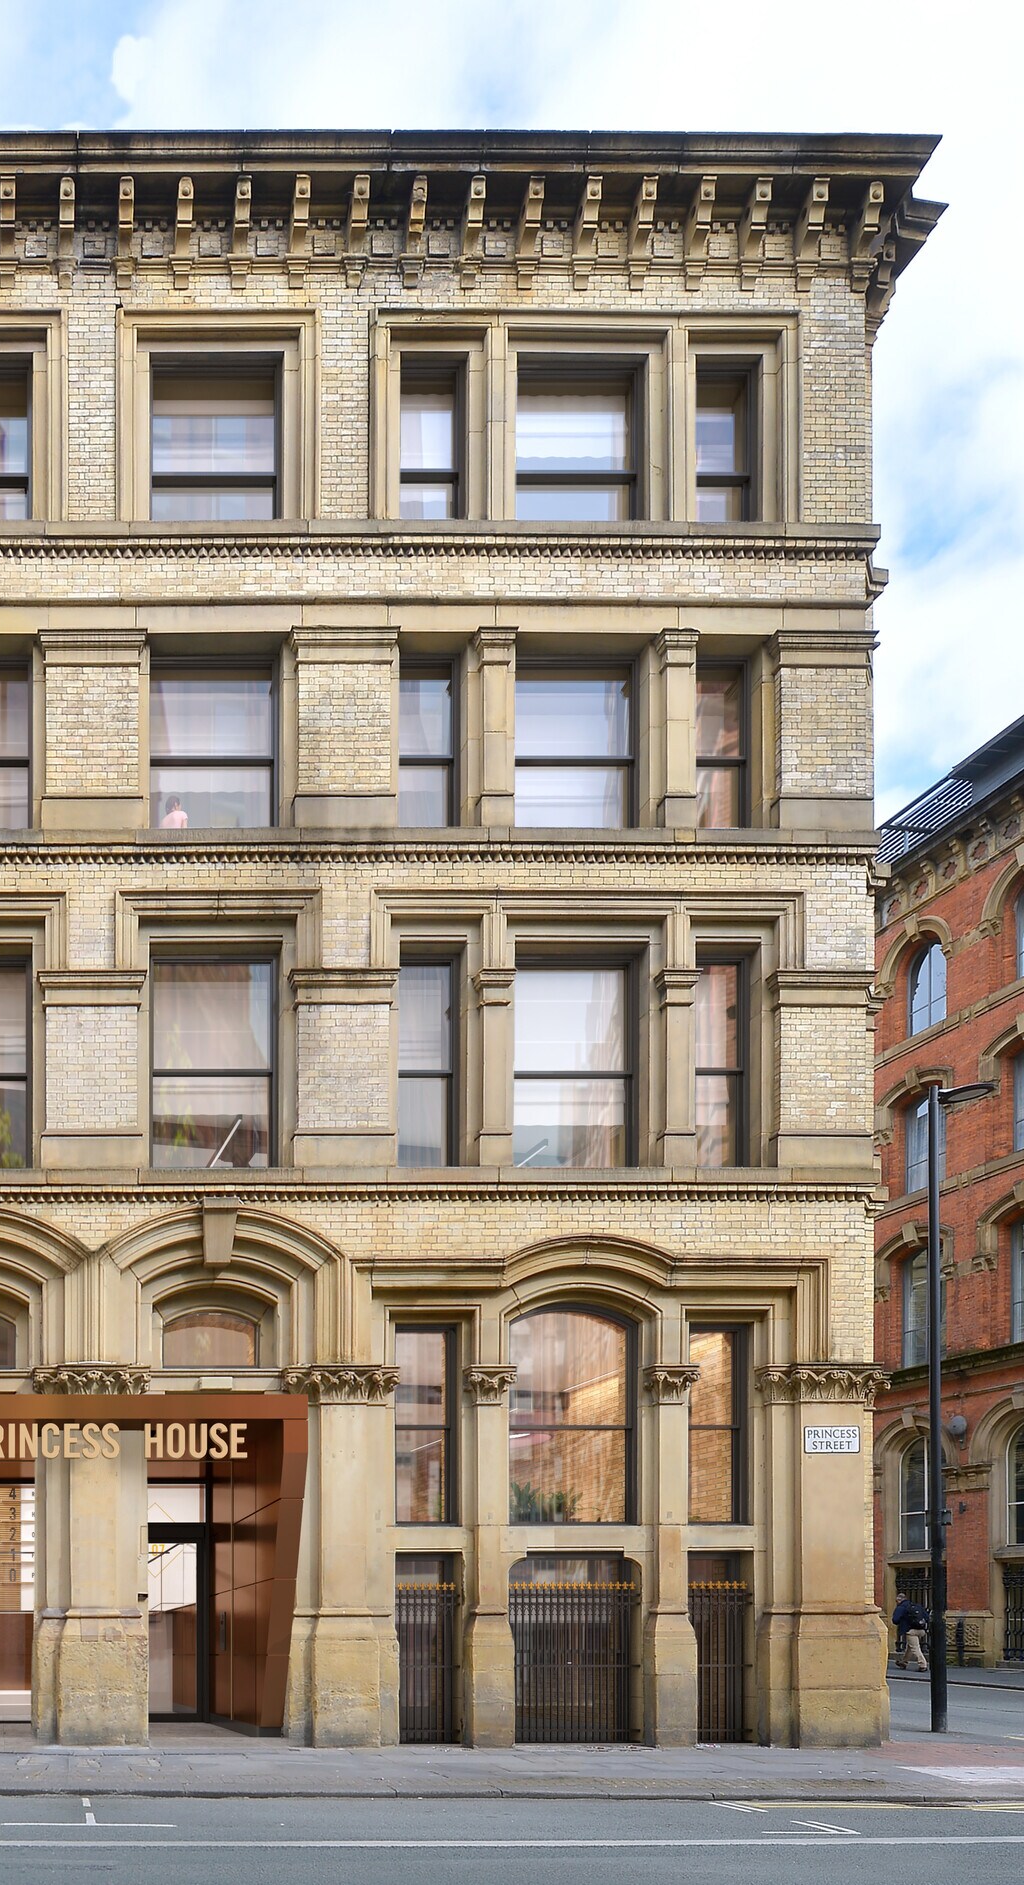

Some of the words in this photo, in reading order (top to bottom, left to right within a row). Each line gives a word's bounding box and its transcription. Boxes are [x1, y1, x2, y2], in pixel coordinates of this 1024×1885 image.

[807, 1428, 857, 1439] PRINCESS
[144, 1422, 248, 1460] HOUSE
[812, 1440, 852, 1450] STREET
[9, 1487, 16, 1500] 4
[9, 1506, 16, 1520] 3
[9, 1527, 16, 1541] 2
[10, 1548, 16, 1561] 1
[151, 1544, 165, 1557] 07
